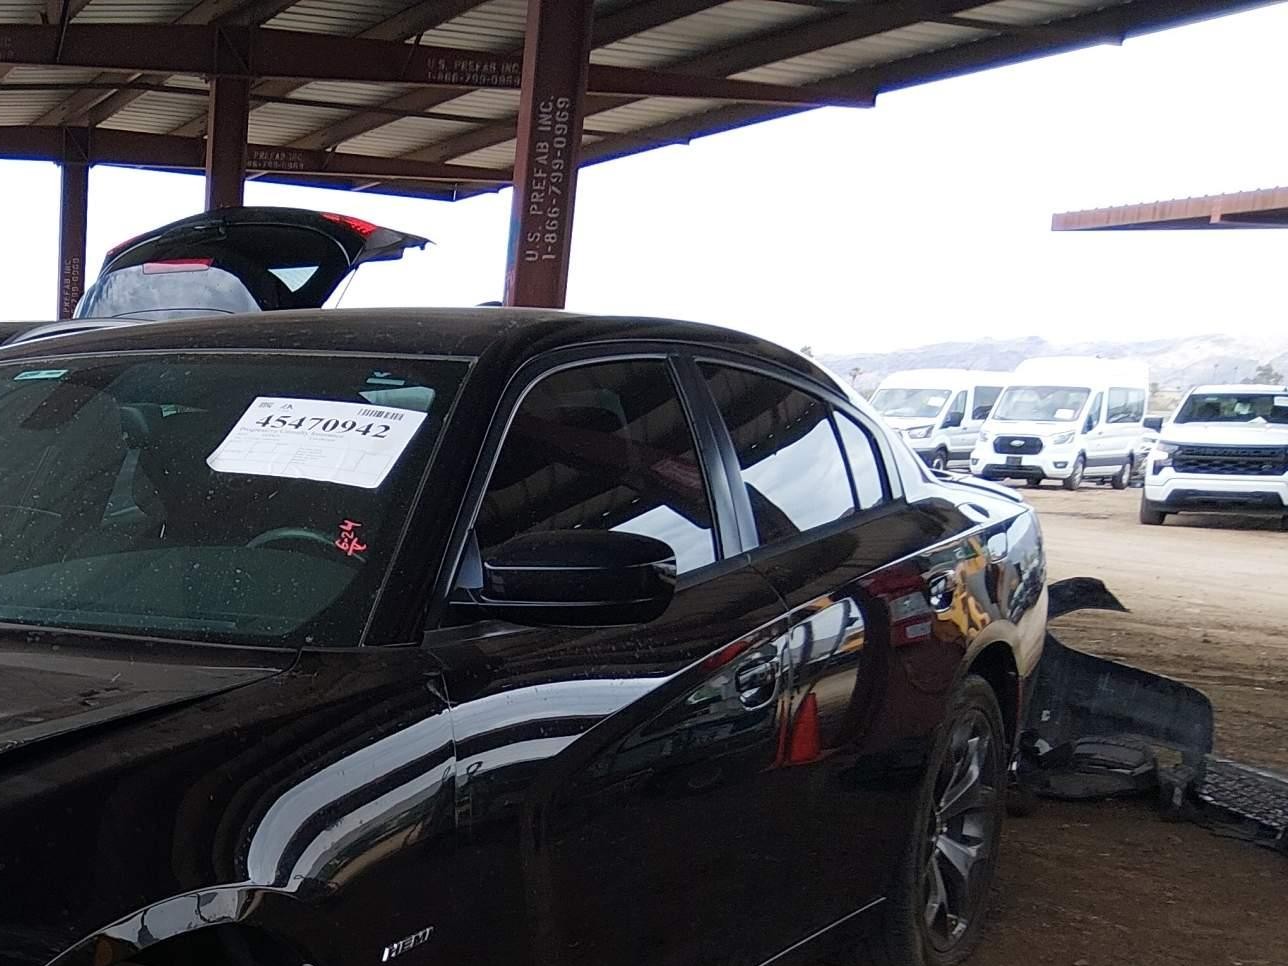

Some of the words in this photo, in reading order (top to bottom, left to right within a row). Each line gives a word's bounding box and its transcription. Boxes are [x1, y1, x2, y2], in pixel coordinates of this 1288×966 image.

[537, 95, 555, 131] INC.
[530, 141, 550, 215] PREFAB
[542, 97, 570, 261] 1-866-799-0969
[525, 226, 543, 262] U.S.
[255, 413, 392, 439] 45470942
